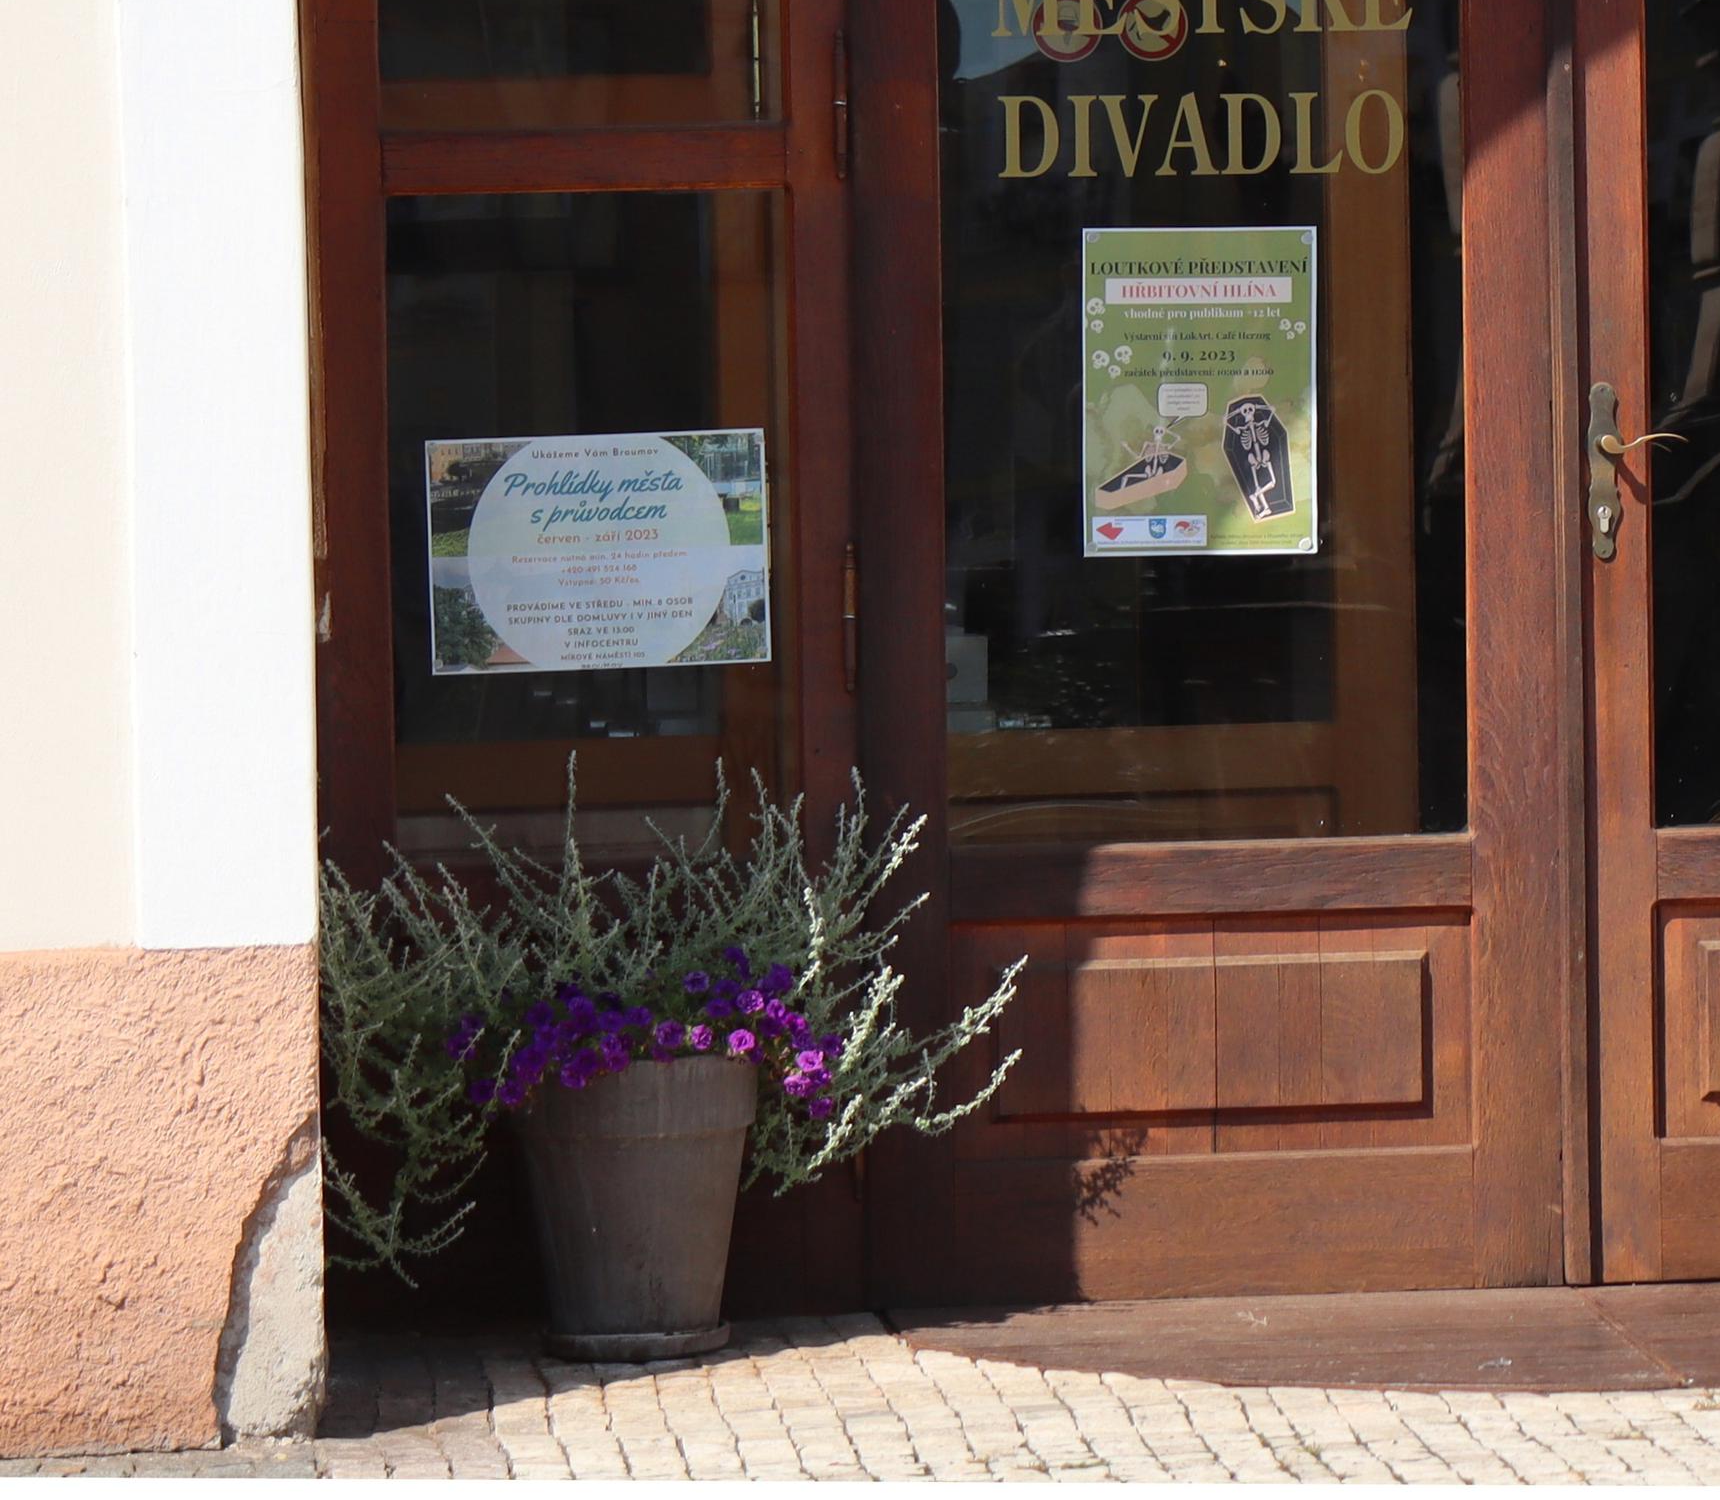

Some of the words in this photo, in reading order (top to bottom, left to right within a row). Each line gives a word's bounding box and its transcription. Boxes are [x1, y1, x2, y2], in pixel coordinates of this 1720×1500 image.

[996, 88, 1405, 179] DIVADLO
[1091, 258, 1184, 276] LOUTKOVÉ
[1188, 257, 1309, 276] PŘEDSTAVENÍ
[1121, 281, 1219, 299] HŘBITOVNÍ
[1223, 281, 1278, 299] HLÍNA
[1123, 307, 1164, 319] vhodné
[1167, 309, 1187, 320] pro
[1189, 307, 1244, 320] publikum
[1266, 306, 1281, 318] let
[1162, 350, 1176, 362] 9.
[1180, 350, 1194, 362] 9.
[1199, 349, 1236, 361] 2023
[503, 469, 614, 503] Prohlídky
[617, 469, 684, 492] města
[530, 508, 545, 525] s
[543, 496, 668, 533] průvodcem
[536, 531, 581, 545] červen
[594, 529, 621, 543] září
[625, 528, 659, 542] 2023
[569, 602, 582, 610] VE
[585, 599, 624, 610] STŘEDU
[666, 597, 694, 606] OSOB
[508, 615, 551, 625] SKUPINY
[553, 615, 573, 624] DLE
[576, 613, 628, 623] DOMLUVY
[671, 609, 693, 619] DEN
[567, 627, 593, 636] SRAZ
[596, 626, 608, 635] VE
[574, 638, 639, 649] INFOCENTRU
